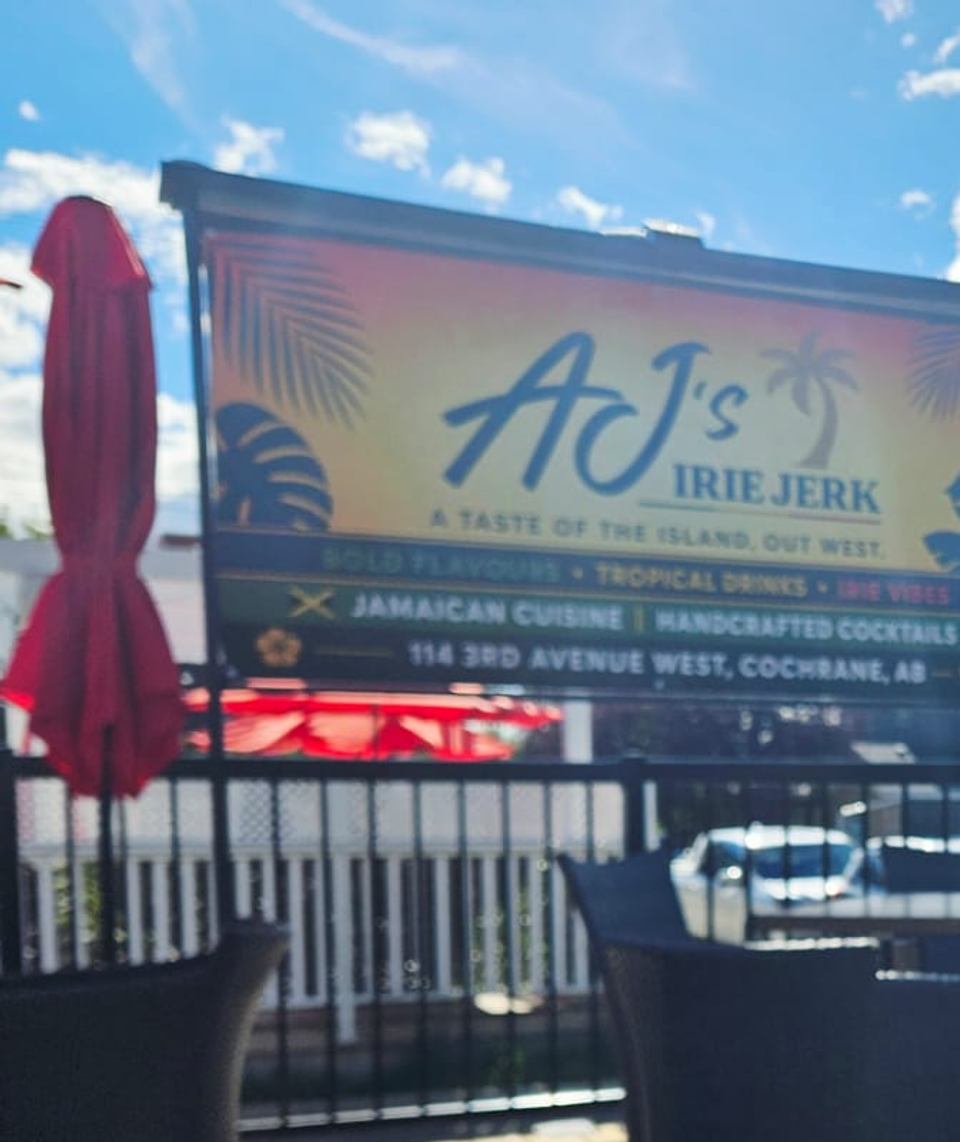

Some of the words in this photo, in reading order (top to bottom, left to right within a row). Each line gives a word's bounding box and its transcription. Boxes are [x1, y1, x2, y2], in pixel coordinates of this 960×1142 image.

[442, 331, 749, 496] AJ's
[673, 463, 765, 501] IRIE
[771, 473, 881, 515] JERK
[431, 507, 446, 526] A
[459, 508, 542, 535] TASTE
[553, 518, 586, 538] OF
[600, 521, 646, 543] THE
[763, 533, 810, 553] OUT
[323, 547, 400, 573] BOLD
[596, 561, 716, 593] TROPICAL
[722, 571, 808, 597] DRINKS
[838, 579, 881, 600] IRIE
[887, 583, 950, 604] VIBES
[353, 592, 506, 624] JAMAICAN
[512, 602, 623, 631] CUISINE
[655, 608, 833, 640] HANDCRAFTED
[836, 621, 958, 646] COCKTAILS
[409, 642, 453, 666] 114
[460, 643, 521, 669] 3RD
[529, 647, 645, 675] AVENUE
[651, 651, 734, 680] WEST,
[737, 655, 890, 685] COCHRANE,
[894, 660, 927, 683] AB
